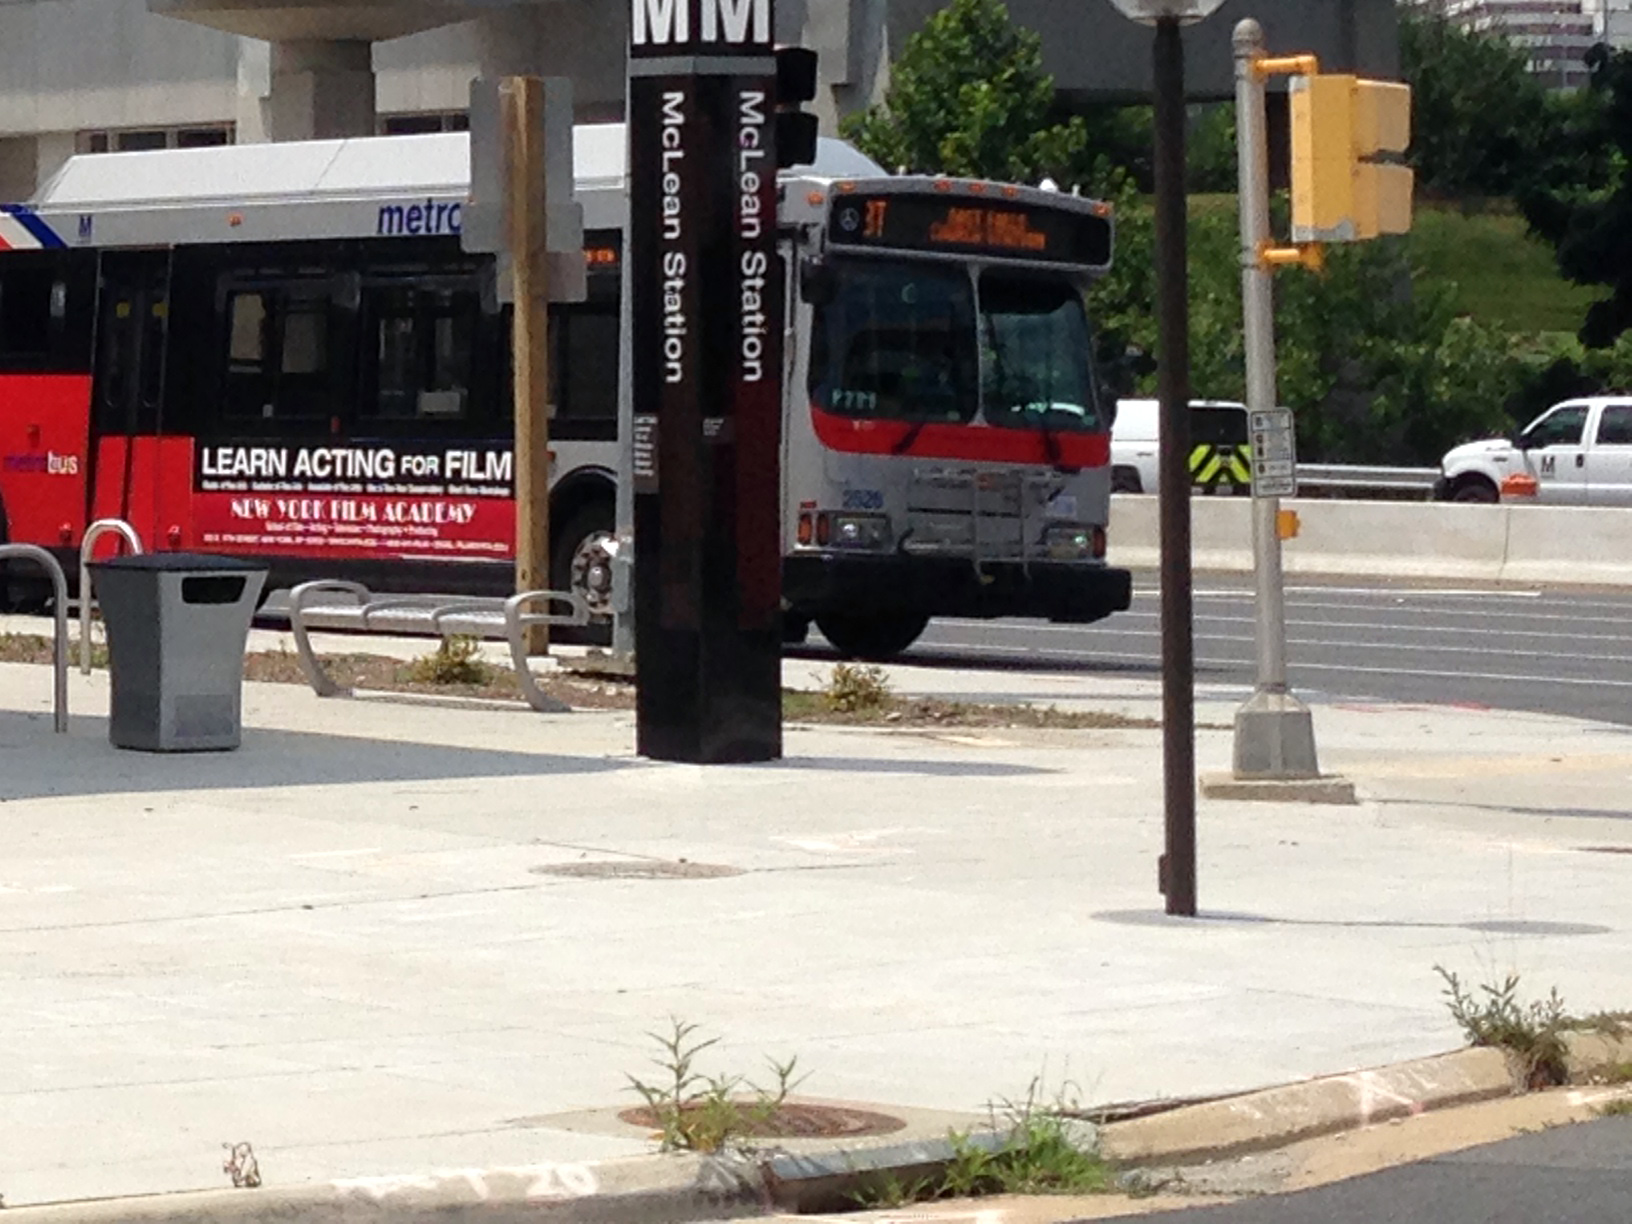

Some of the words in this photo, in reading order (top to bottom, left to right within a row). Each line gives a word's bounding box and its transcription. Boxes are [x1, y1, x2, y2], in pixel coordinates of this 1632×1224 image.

[661, 91, 685, 240] McLean
[739, 91, 765, 239] McLean
[663, 251, 687, 384] Station
[741, 250, 767, 382] Station
[201, 447, 287, 476] LEARN
[294, 448, 396, 478] ACTING
[401, 455, 440, 475] FOR
[445, 451, 513, 480] FILM
[230, 498, 269, 519] NEW
[276, 499, 327, 520] YORK
[330, 500, 378, 522] FILM
[383, 501, 477, 524] ACADEMY
